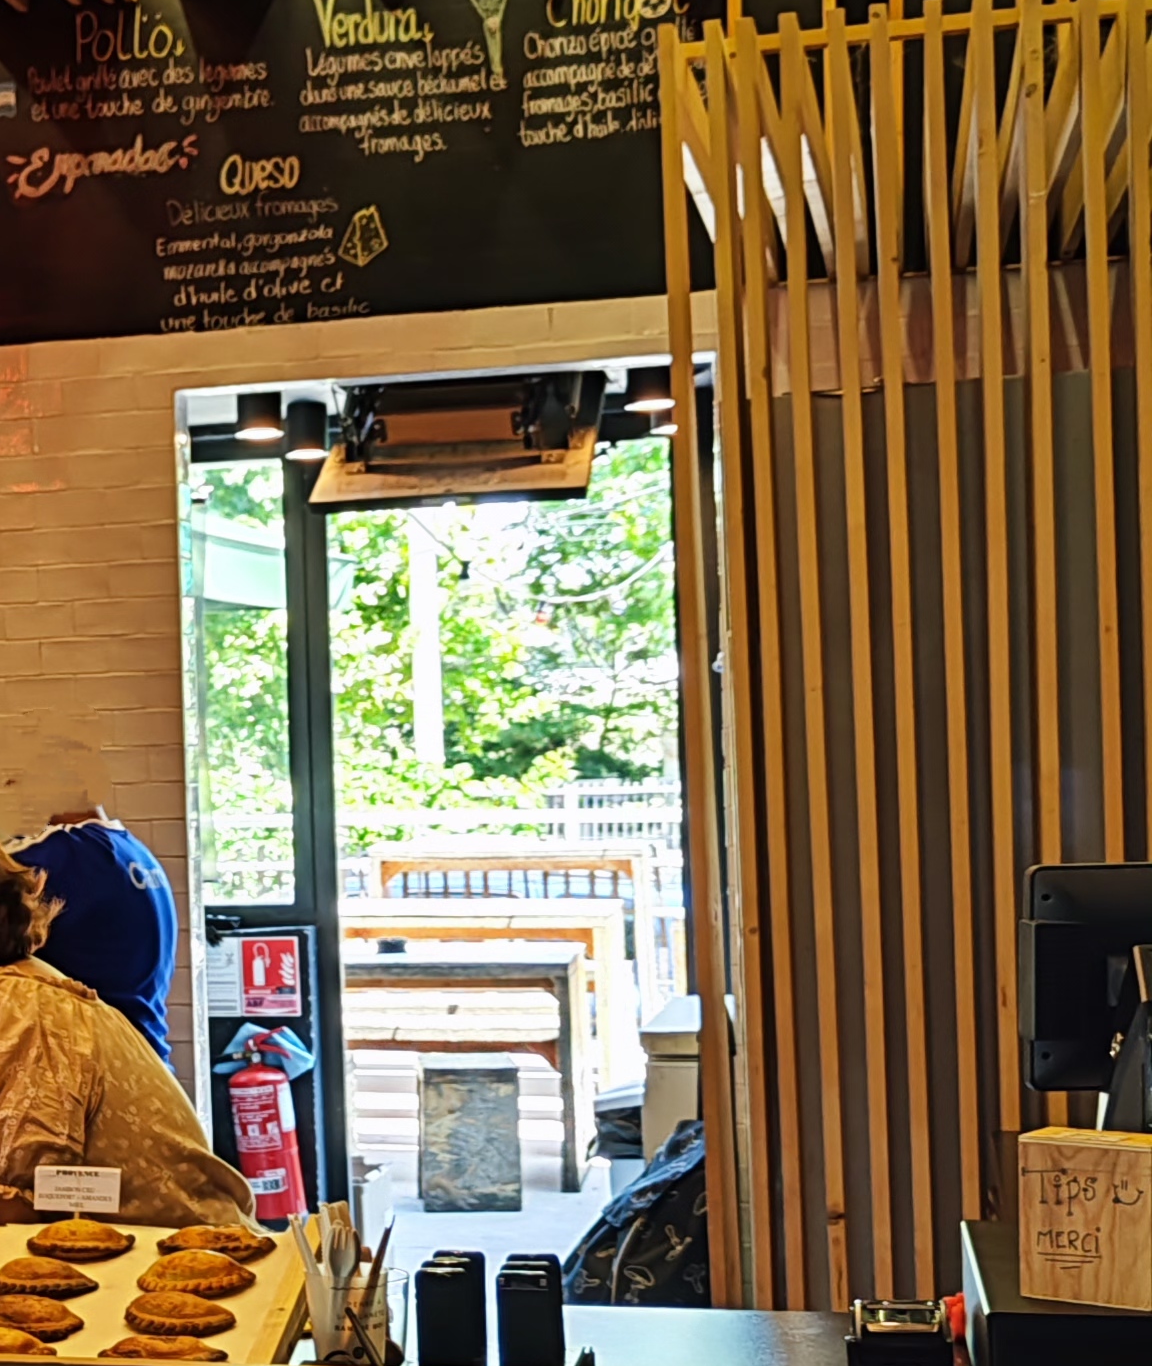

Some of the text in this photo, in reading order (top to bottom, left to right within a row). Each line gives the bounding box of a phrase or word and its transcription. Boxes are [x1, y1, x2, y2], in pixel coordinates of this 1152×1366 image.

[118, 68, 160, 91] avec
[162, 57, 195, 85] des
[151, 87, 179, 115] de
[254, 190, 339, 224] fromages
[320, 270, 346, 295] et
[159, 315, 197, 333] une
[273, 301, 295, 324] de
[1021, 1166, 1098, 1217] Tips
